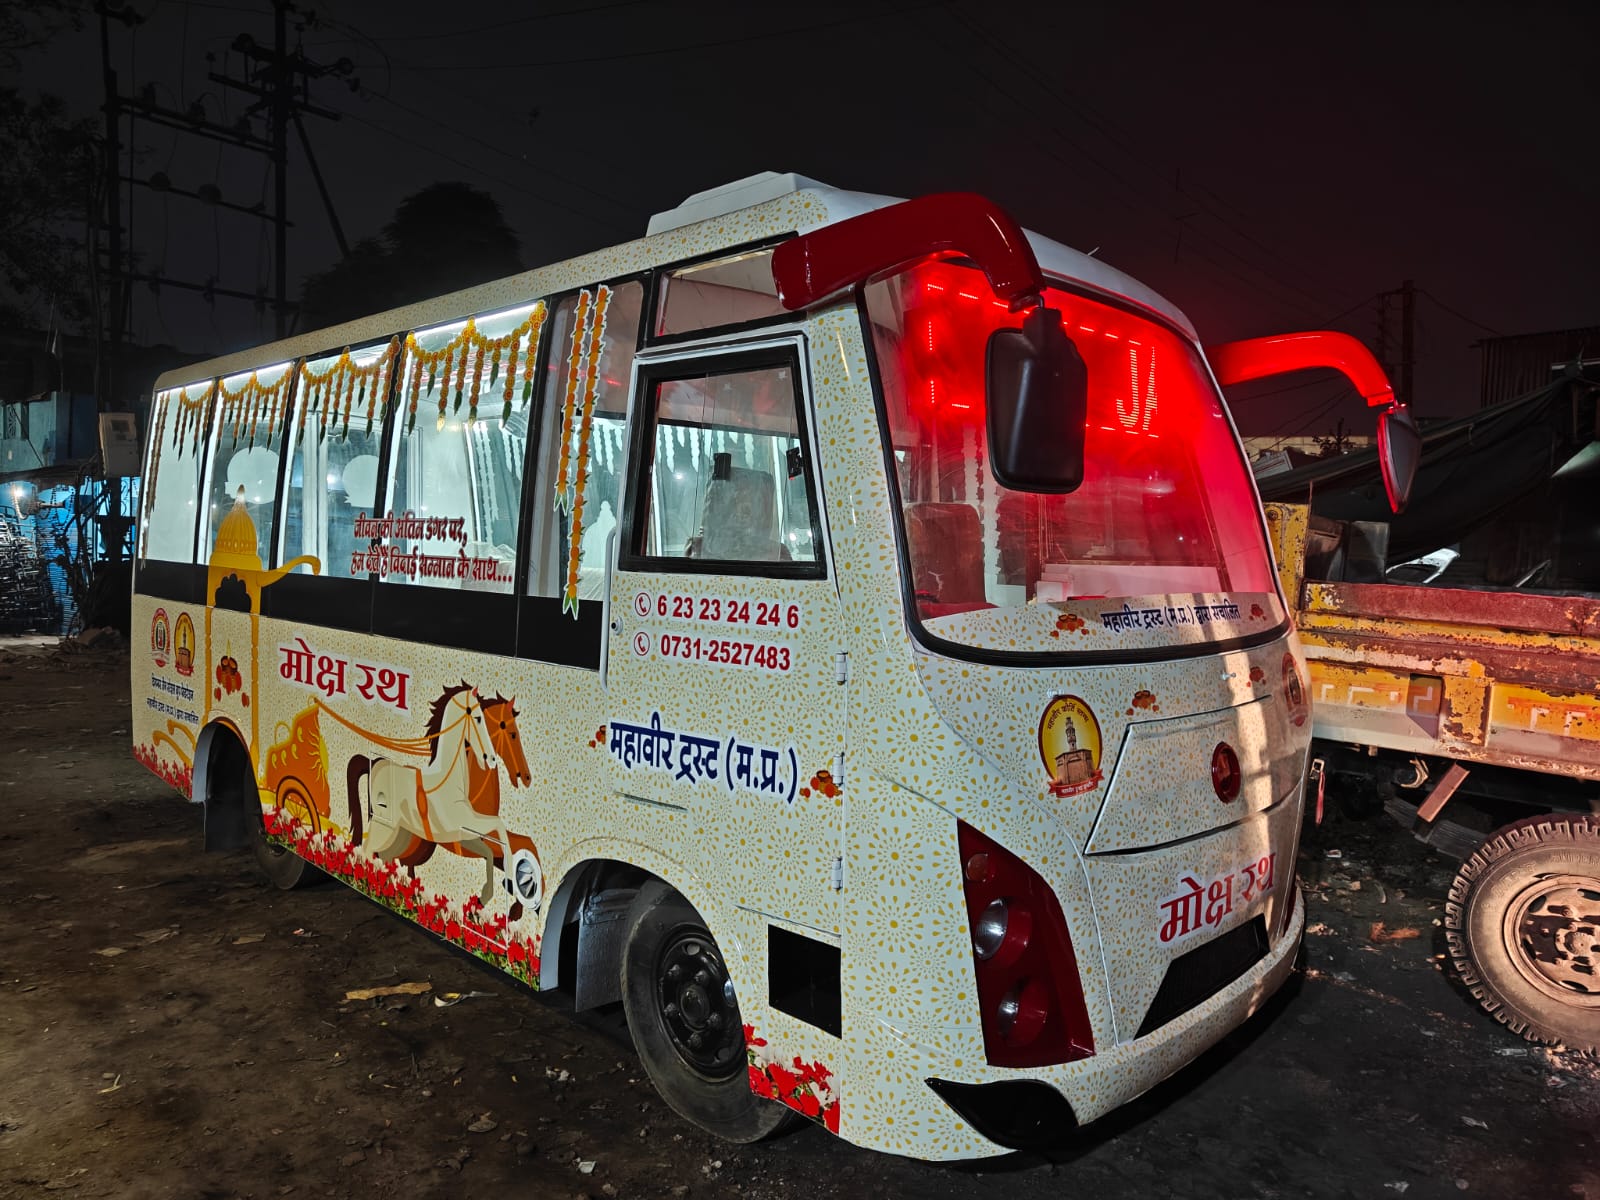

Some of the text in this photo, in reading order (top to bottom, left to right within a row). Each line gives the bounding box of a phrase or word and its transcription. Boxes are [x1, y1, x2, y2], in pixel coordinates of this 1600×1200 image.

[354, 512, 379, 540] जीवन
[379, 510, 394, 539] की
[394, 510, 424, 540] अंतिम
[425, 516, 447, 543] डगर
[390, 545, 419, 582] विदाई
[419, 552, 456, 579] सम्मान
[457, 547, 470, 579] के
[1100, 603, 1143, 633] महावीर
[1141, 608, 1165, 630] ट्रस्ट
[1164, 604, 1195, 628] (म.प्र.)
[1211, 598, 1240, 622] संचालित
[660, 634, 791, 671] 0731-2527483
[279, 637, 410, 710] मोक्ष रथ
[610, 711, 798, 804] महावीर ट्रस्ट (म.प्र.)
[1159, 853, 1276, 943] मोक्ष रथ
